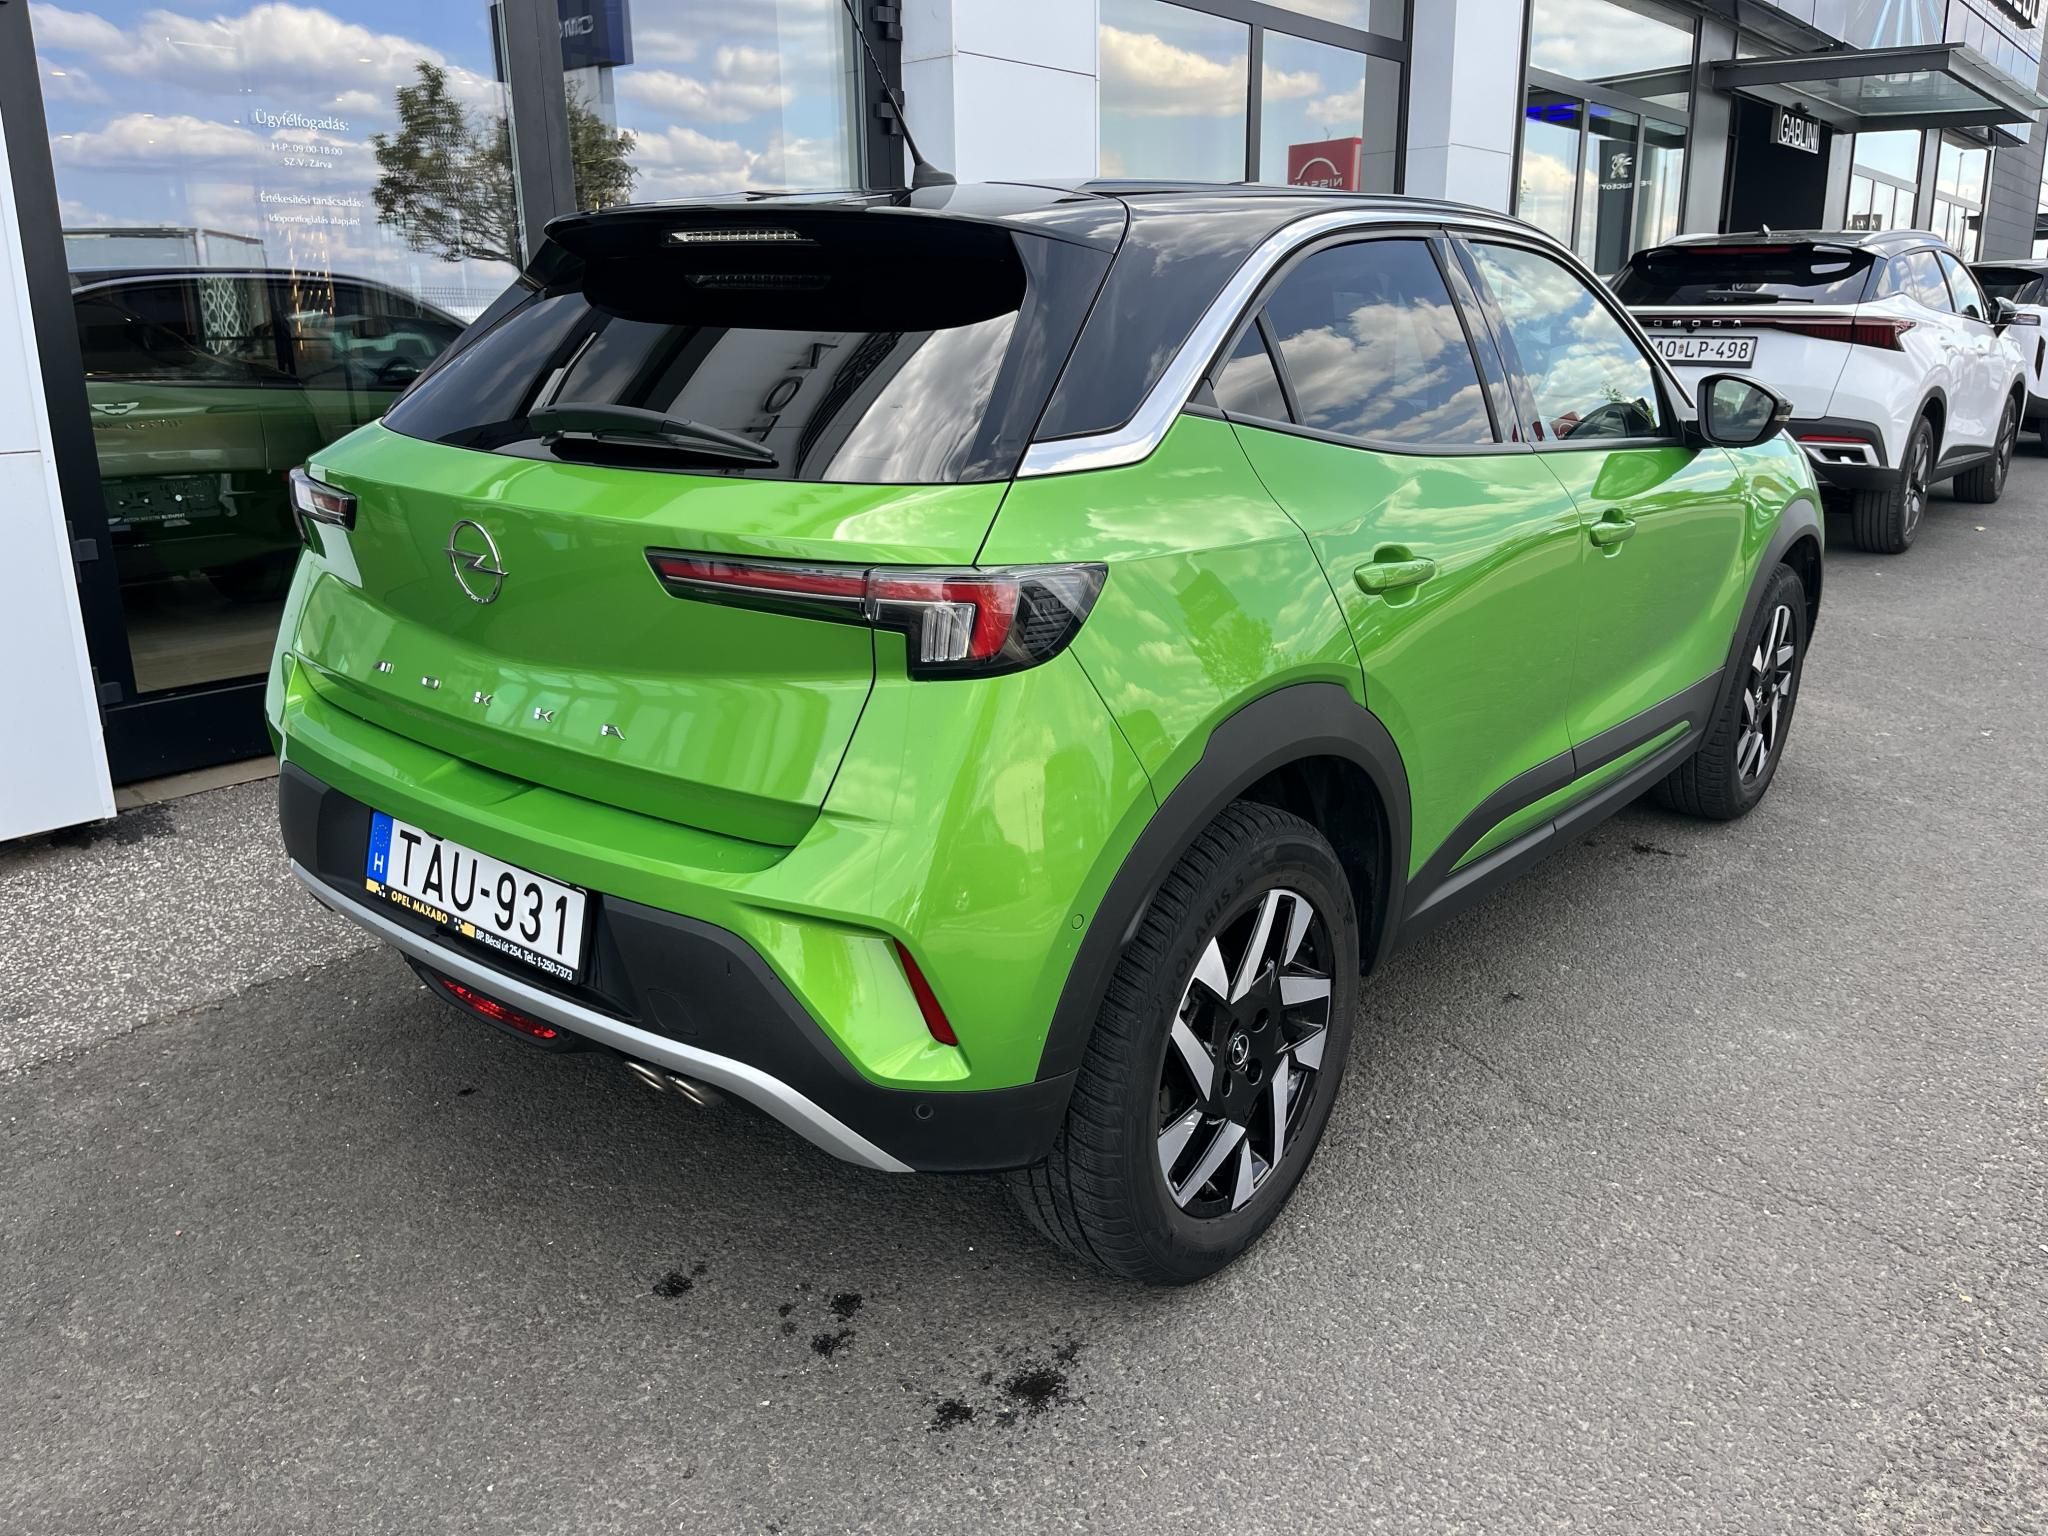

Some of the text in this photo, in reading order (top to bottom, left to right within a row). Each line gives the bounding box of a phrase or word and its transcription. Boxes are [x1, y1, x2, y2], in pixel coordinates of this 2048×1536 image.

[255, 108, 350, 131] Ügyfélfogadás:
[1781, 114, 1818, 150] GABLINI
[309, 158, 332, 169] Zárva
[260, 190, 365, 207] Értékesítési tanácsadás:
[1653, 319, 1742, 327] OMODA
[1684, 341, 1749, 359] LP-498
[374, 852, 384, 874] H
[399, 829, 568, 955] TAU-931
[391, 891, 448, 924] OPEL MAXABO
[485, 933, 501, 949] Bécsi
[509, 944, 522, 959] 254.
[537, 956, 573, 981] 1-250-7373
